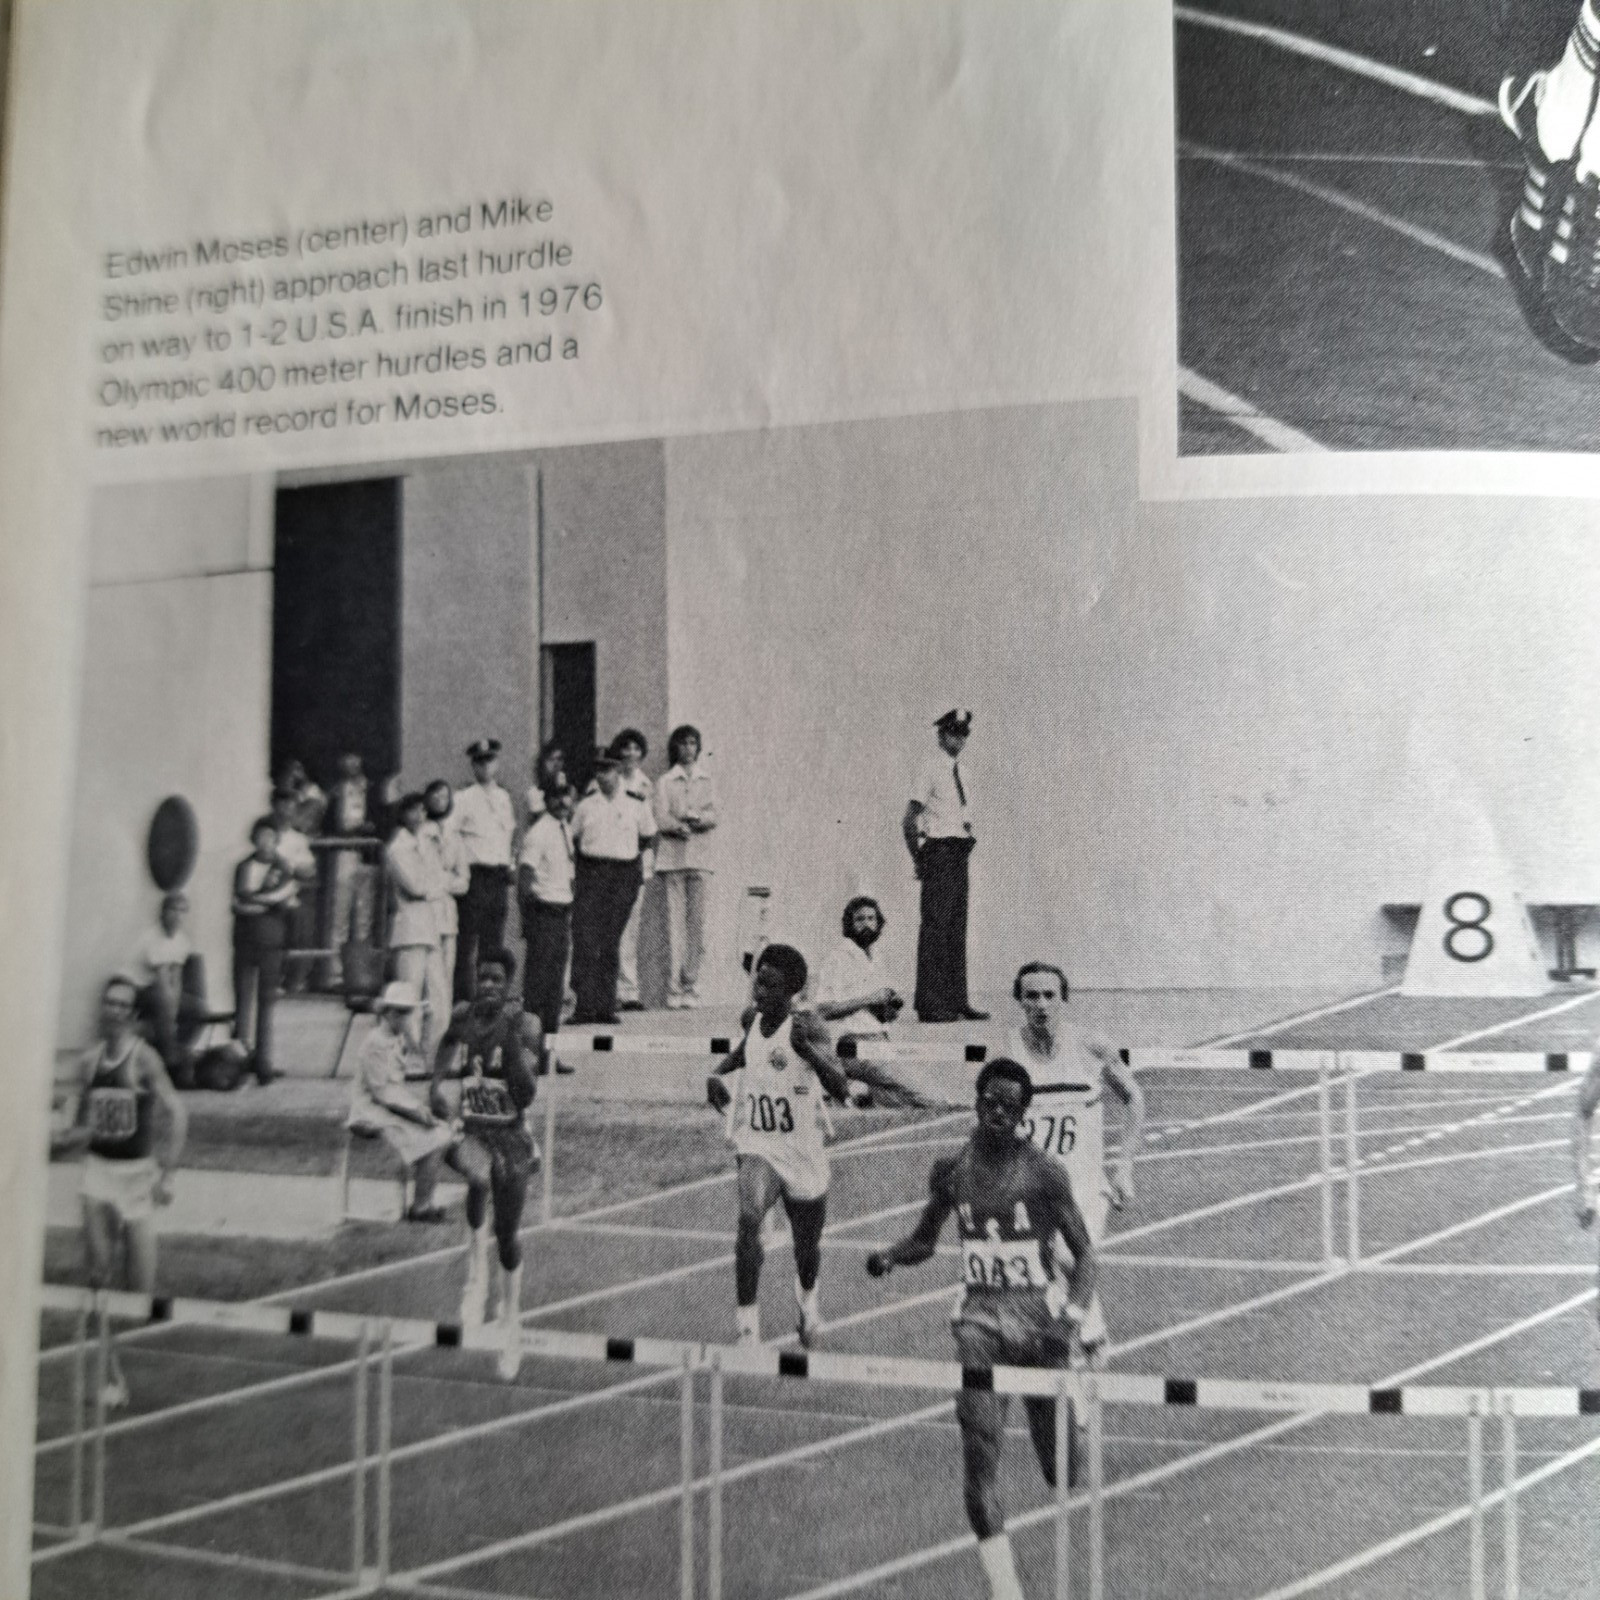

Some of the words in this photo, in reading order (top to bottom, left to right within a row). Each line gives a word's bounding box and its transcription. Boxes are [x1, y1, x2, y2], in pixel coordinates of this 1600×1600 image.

[105, 248, 188, 279] Edwin
[194, 236, 289, 264] Moses
[299, 215, 409, 259] (center)
[417, 206, 473, 239] and
[481, 198, 553, 230] Mike
[104, 292, 180, 322] Shine
[187, 278, 266, 316] (right)
[273, 260, 410, 302] approach
[419, 252, 469, 284] last
[478, 240, 574, 276] hurdle
[102, 341, 134, 364] on
[142, 334, 197, 361] way
[205, 327, 232, 351] to
[242, 317, 288, 348] 1-2
[296, 306, 386, 344] U.S.A.
[395, 296, 474, 330] finish
[483, 296, 507, 322] in
[520, 282, 604, 318] 1976
[98, 374, 211, 411] Olympic
[218, 363, 276, 394] 400
[284, 355, 370, 388] meter
[376, 344, 487, 379] hurdles
[496, 334, 553, 368] and
[561, 336, 580, 361] a
[95, 424, 151, 449] new
[160, 410, 237, 443] world
[243, 400, 338, 436] record
[346, 398, 387, 426] for
[393, 392, 505, 422] Moses.
[1443, 891, 1494, 963] 8
